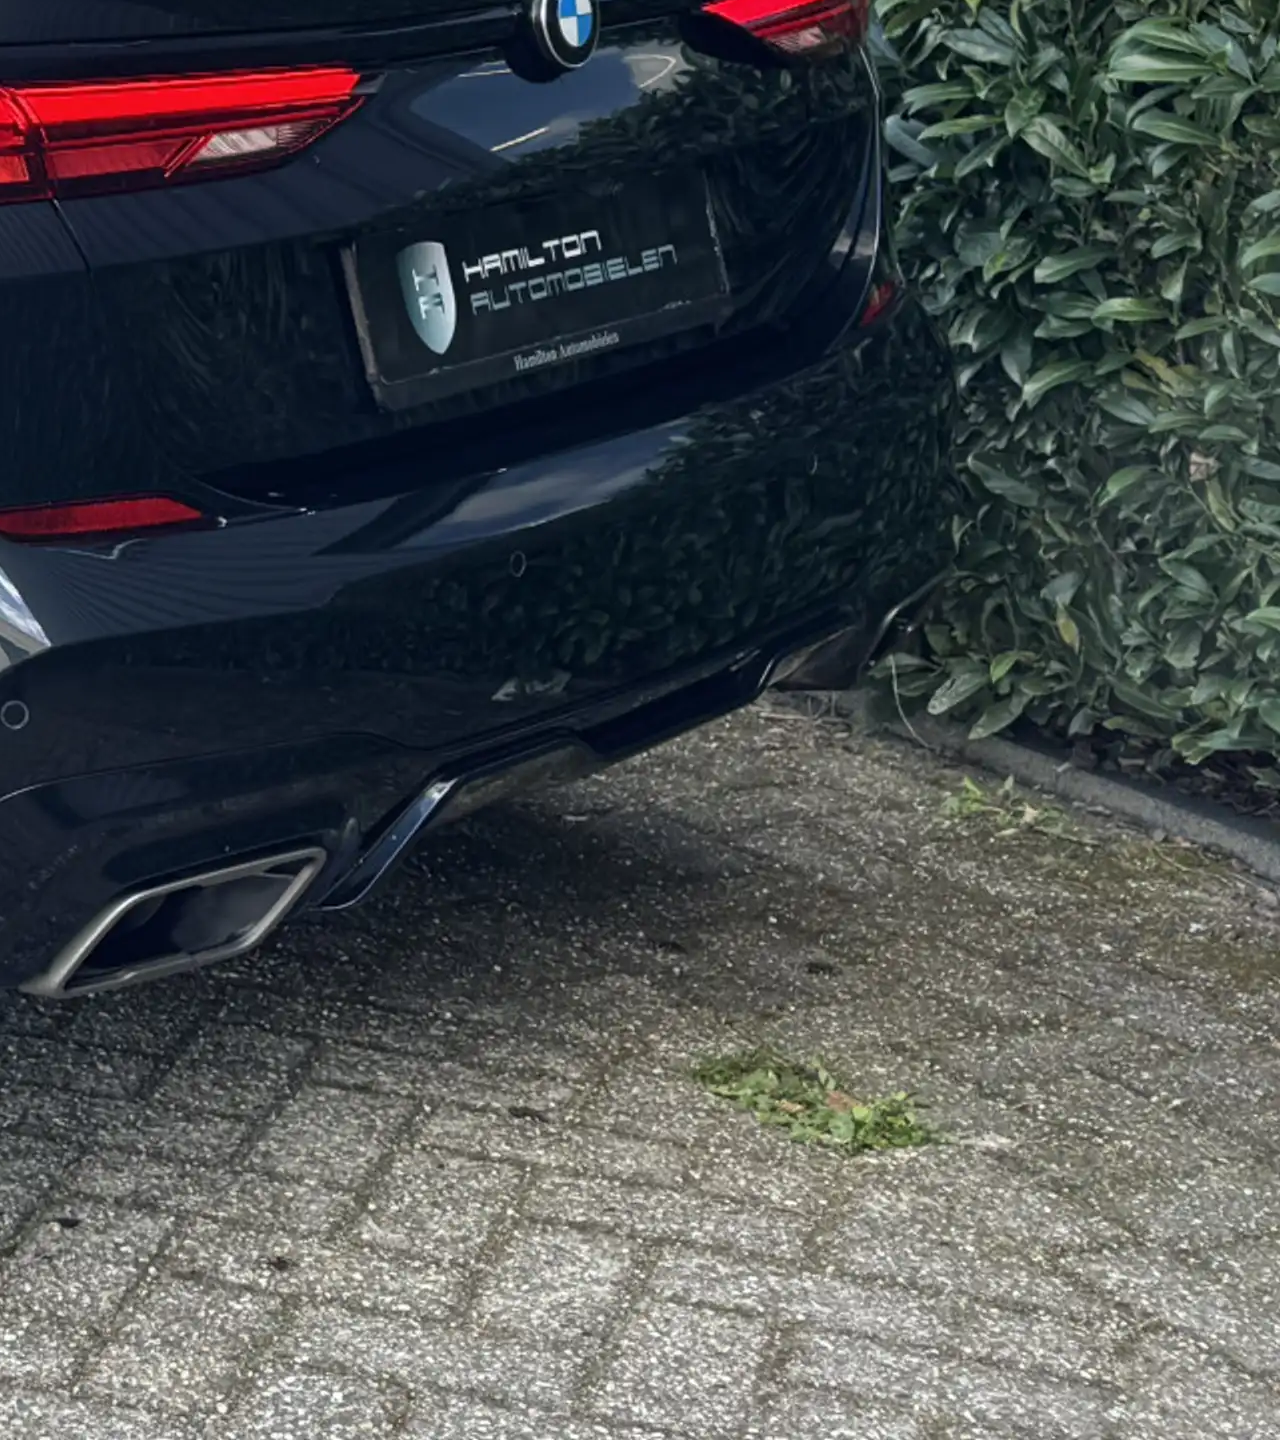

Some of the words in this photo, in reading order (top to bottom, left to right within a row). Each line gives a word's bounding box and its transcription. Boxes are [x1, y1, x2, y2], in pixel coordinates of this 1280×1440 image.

[462, 230, 603, 283] HAMILTON
[470, 244, 678, 315] AUTOMOBIELEN
[513, 345, 558, 371] Hamilton
[559, 331, 620, 360] Automobielen
